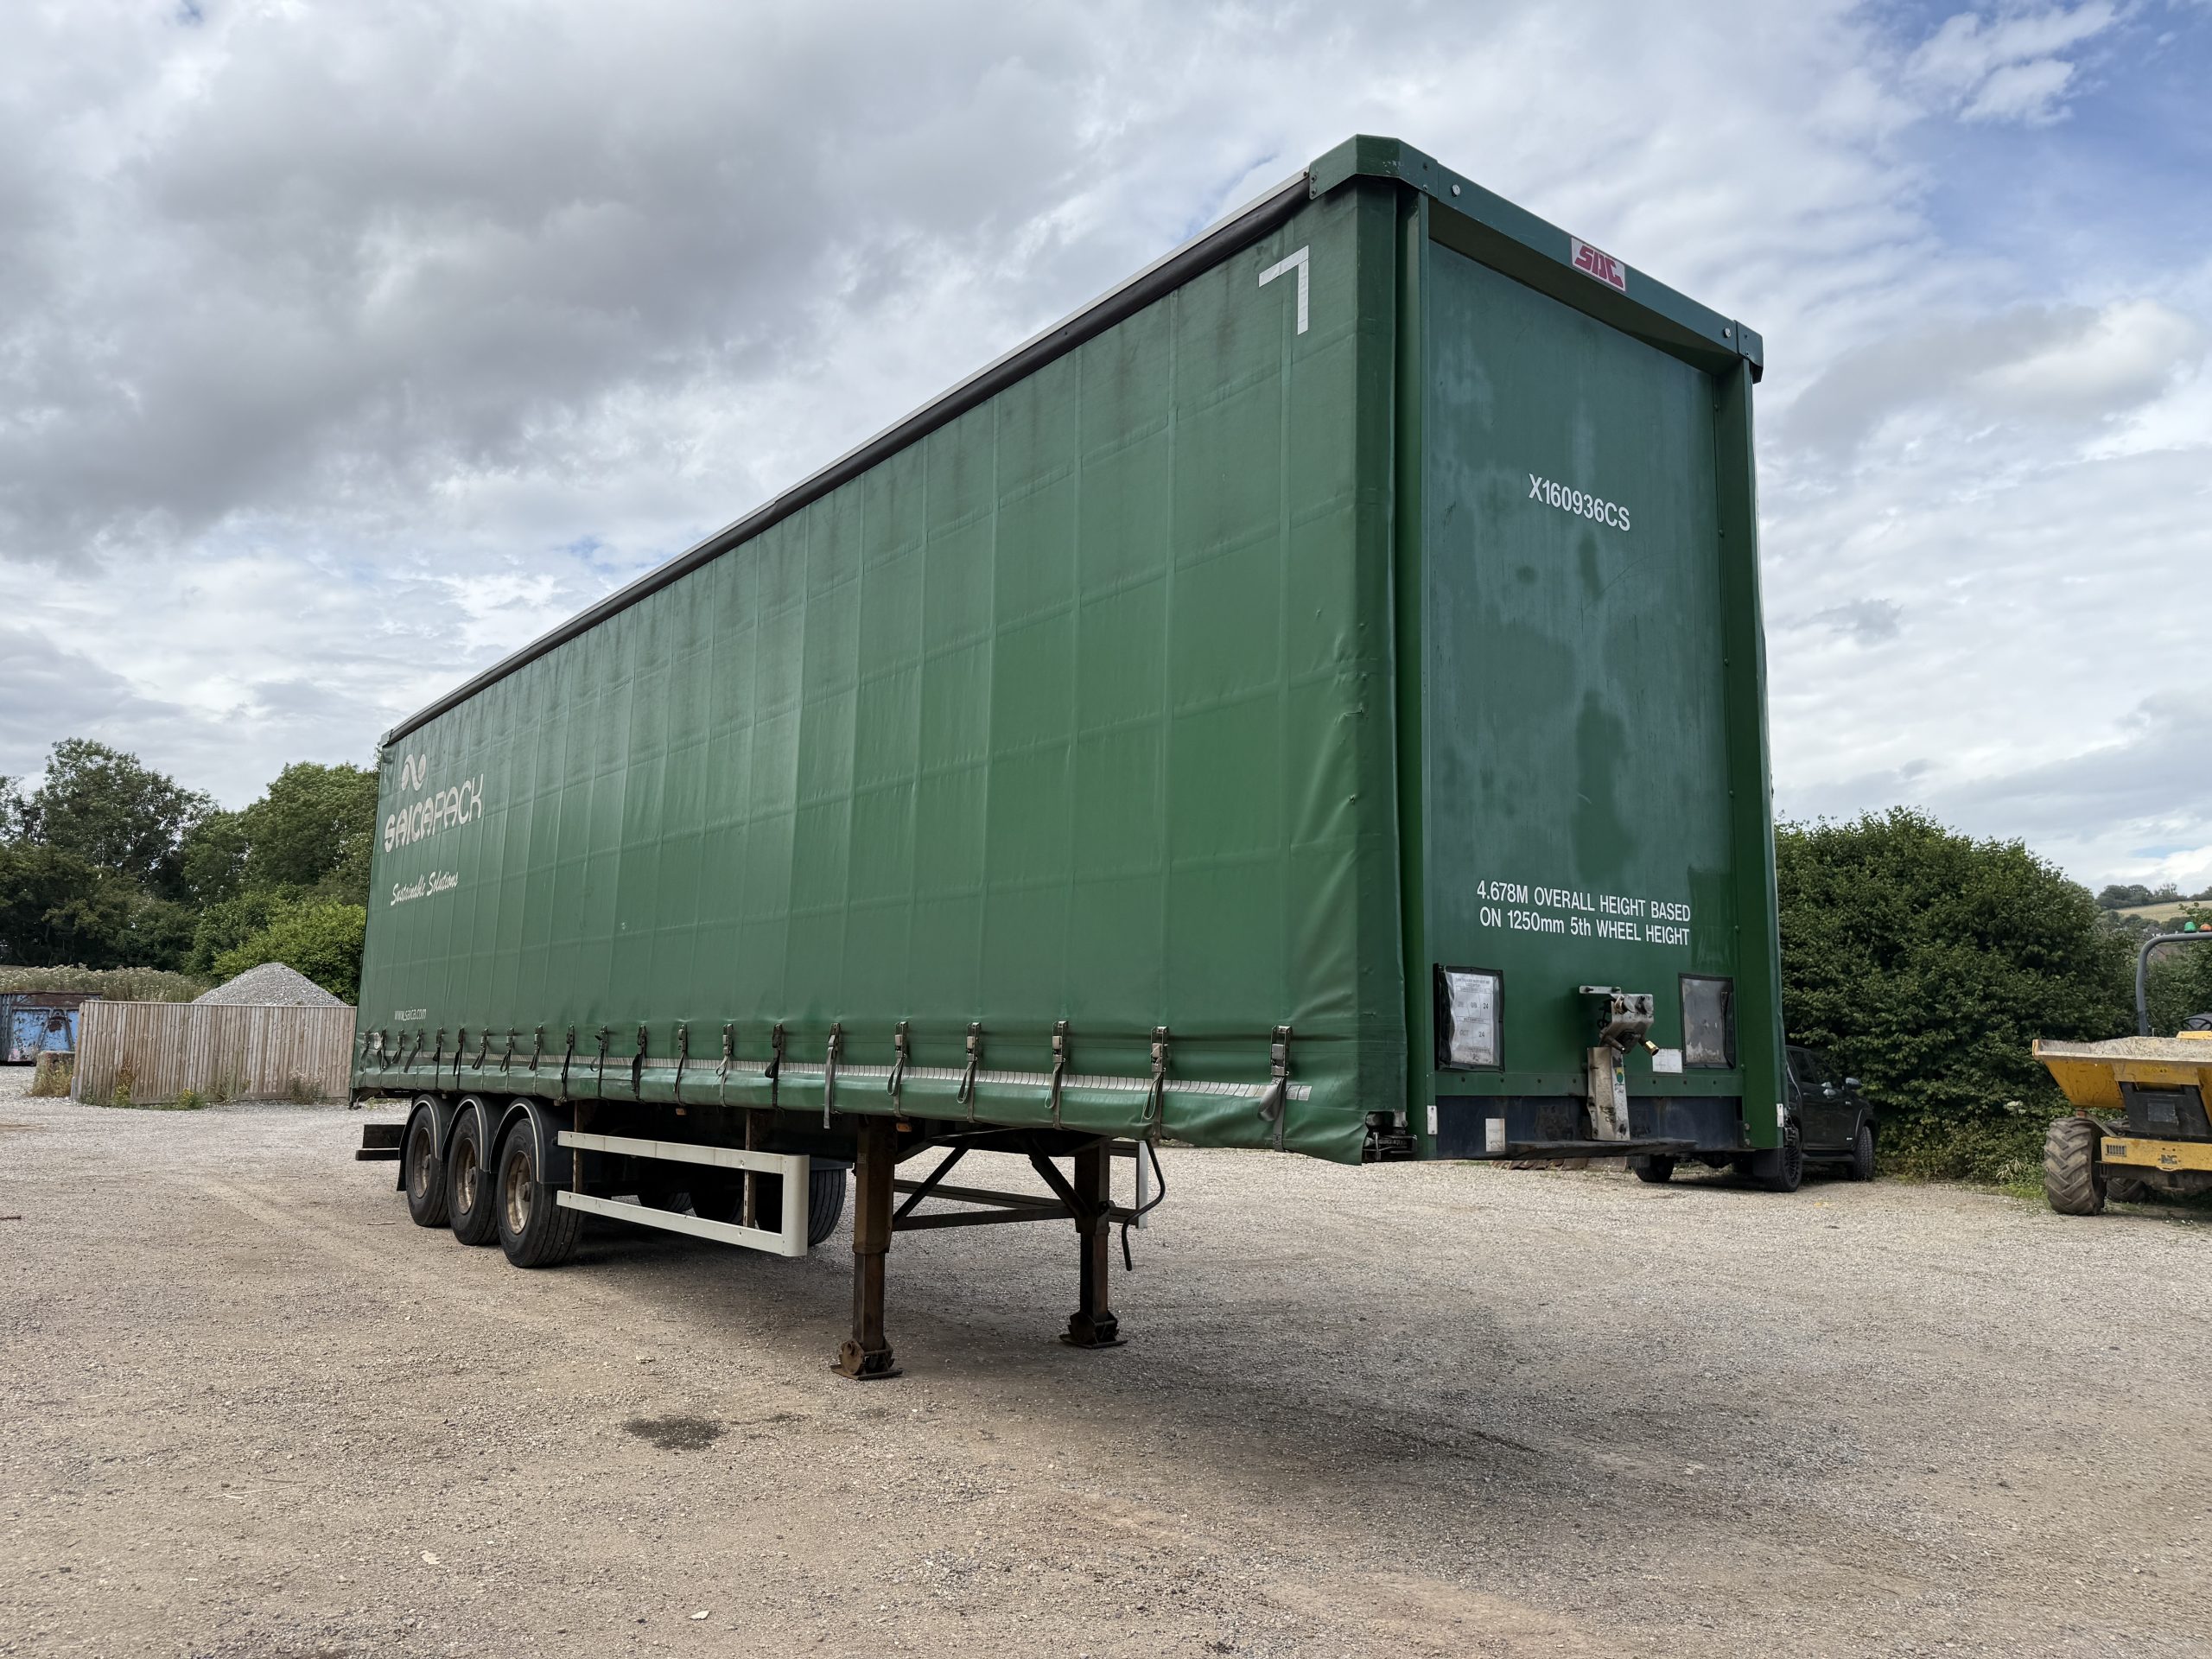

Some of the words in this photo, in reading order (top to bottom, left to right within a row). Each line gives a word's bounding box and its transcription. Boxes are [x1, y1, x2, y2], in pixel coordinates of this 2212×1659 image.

[1529, 474, 1630, 531] X160936CS
[426, 870, 459, 896] Solutions
[1477, 880, 1529, 904] 4.678M
[1534, 887, 1595, 912] OVERALL
[1599, 895, 1645, 917] HEIGHT
[1651, 900, 1691, 922] BASED
[1479, 906, 1502, 928] ON
[1507, 910, 1565, 934] 1250mm
[1570, 917, 1591, 937] 5th
[1596, 918, 1642, 941] WHEEL
[1646, 925, 1690, 946] HEIGHT
